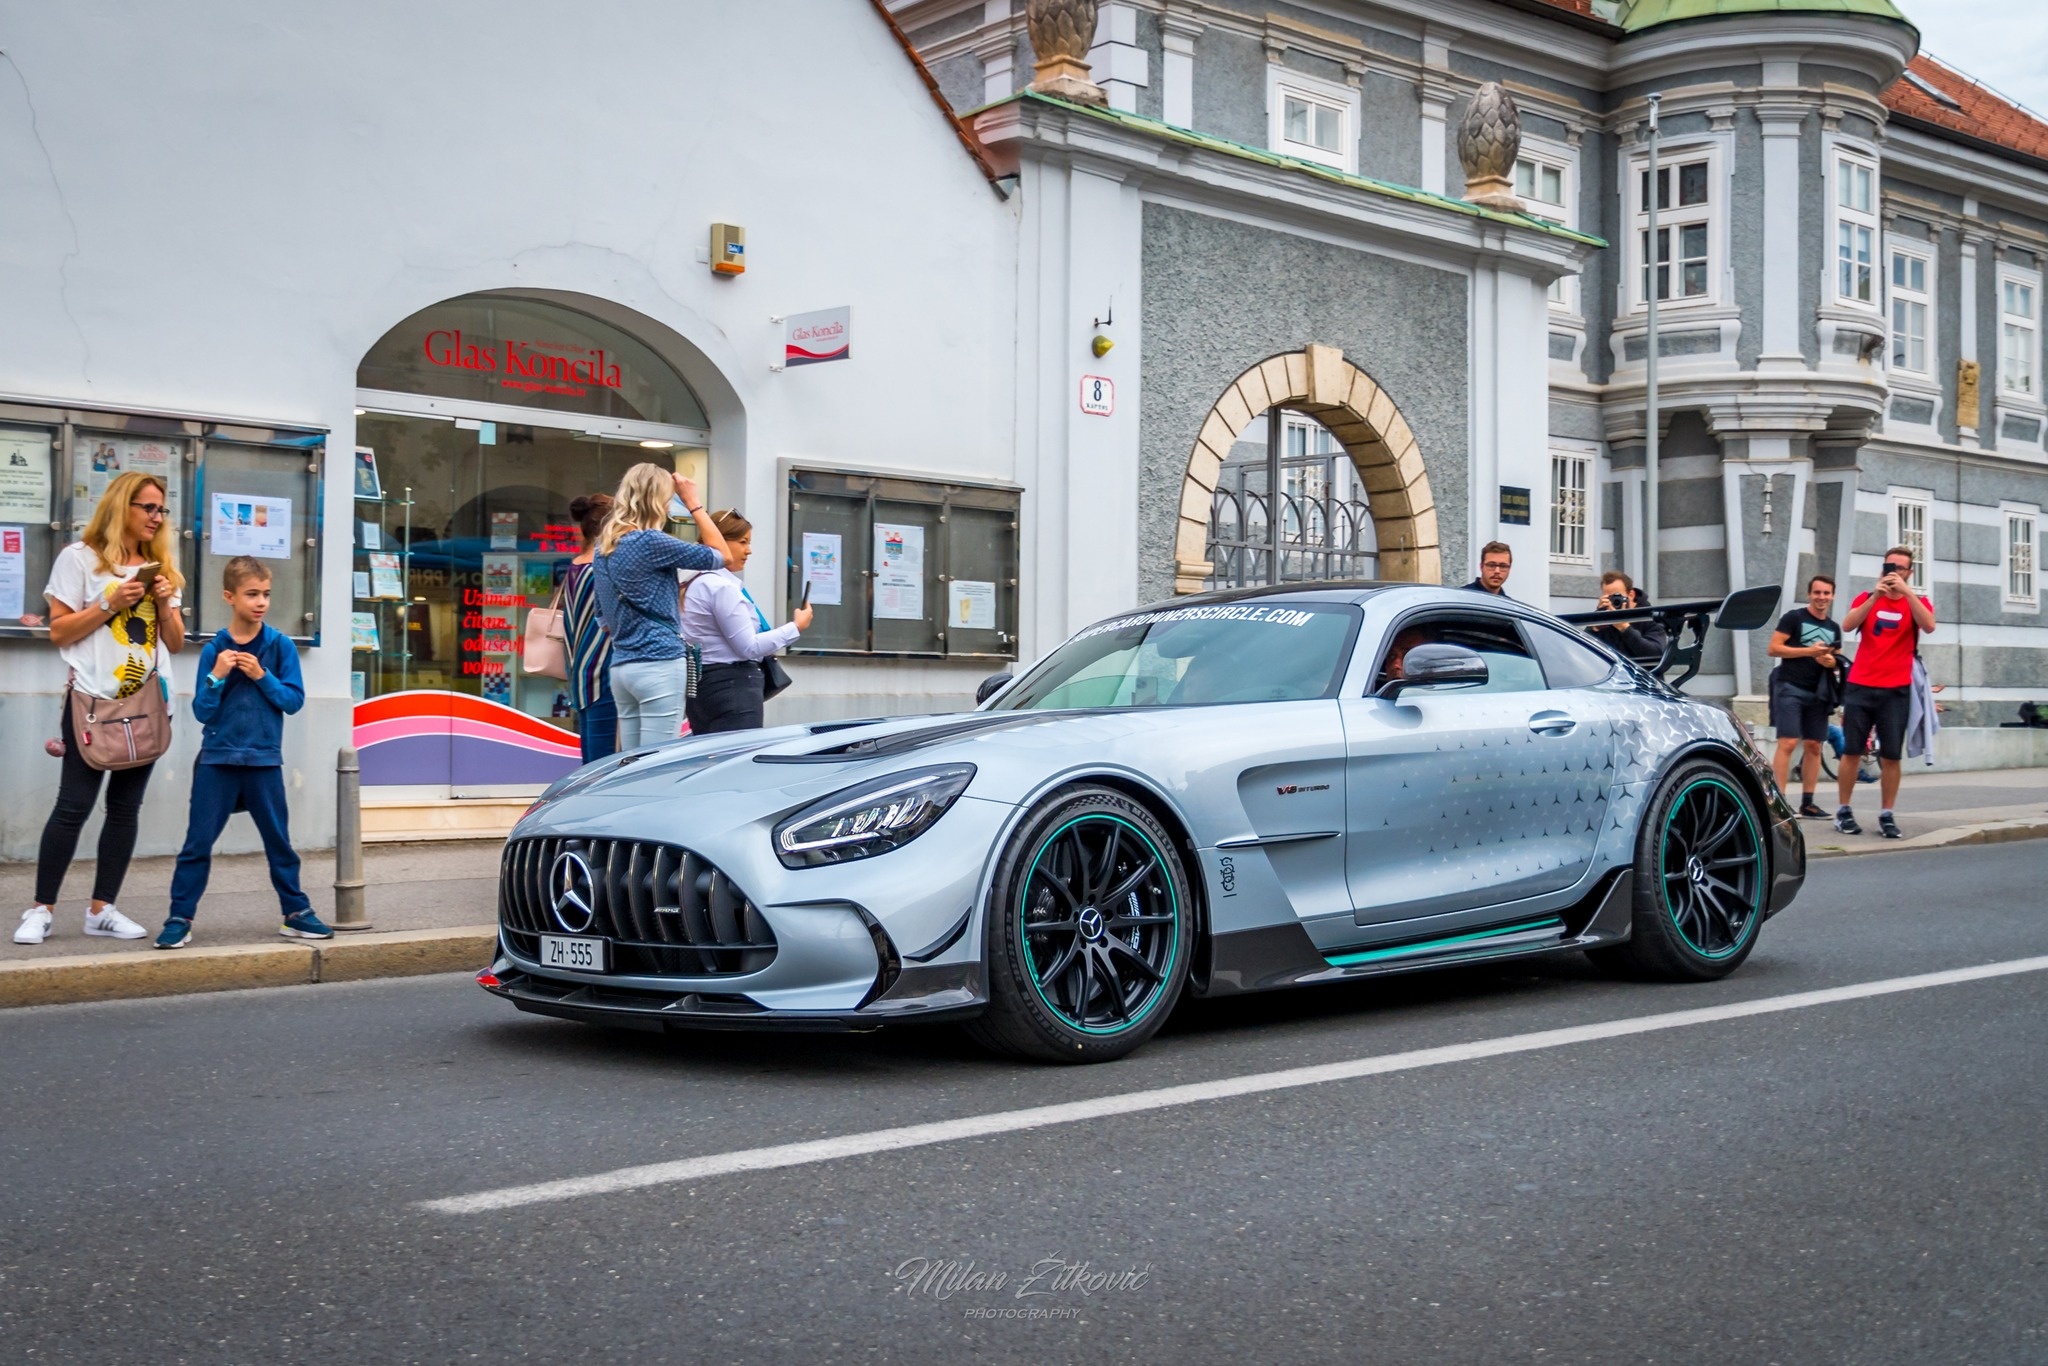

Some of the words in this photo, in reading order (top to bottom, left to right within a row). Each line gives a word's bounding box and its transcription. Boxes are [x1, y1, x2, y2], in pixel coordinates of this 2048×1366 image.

[424, 330, 497, 371] Glas
[504, 340, 622, 388] Koncila
[1094, 380, 1102, 401] 8
[463, 656, 504, 675] volim
[1131, 805, 1177, 860] MICHELIN
